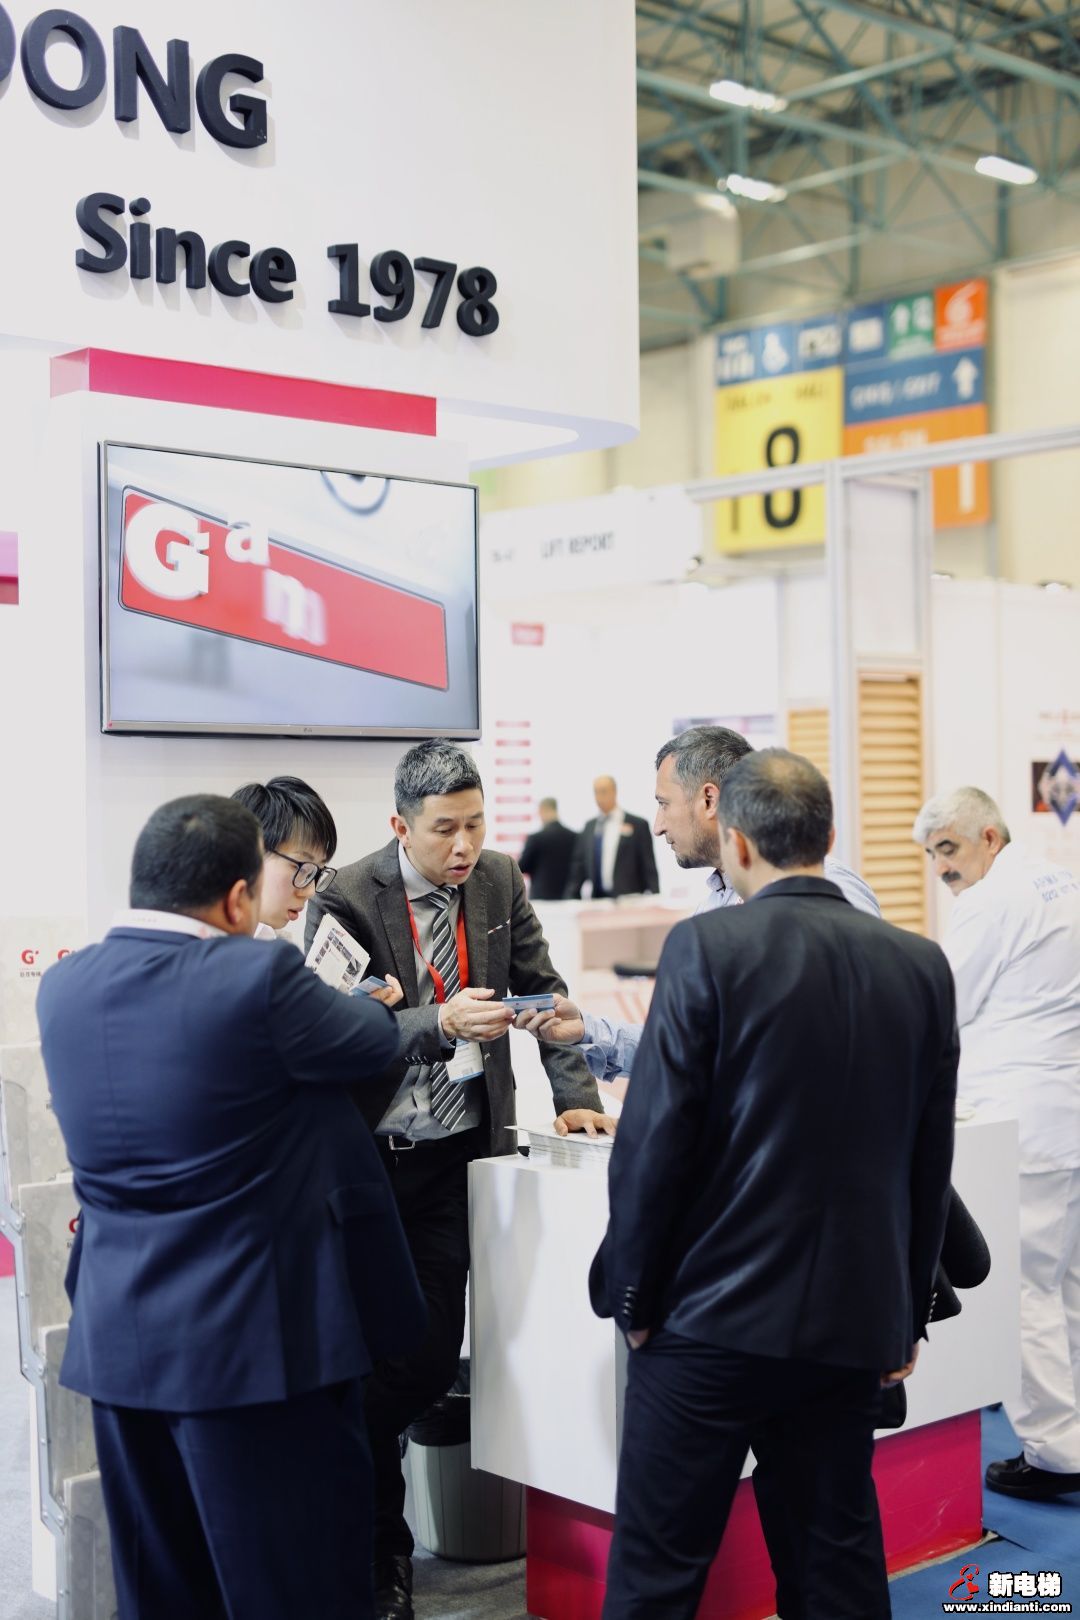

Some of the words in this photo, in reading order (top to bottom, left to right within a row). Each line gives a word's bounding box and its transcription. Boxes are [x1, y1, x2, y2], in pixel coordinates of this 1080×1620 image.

[0, 2, 269, 149] ONG
[76, 192, 297, 303] Since
[327, 243, 500, 337] 1978
